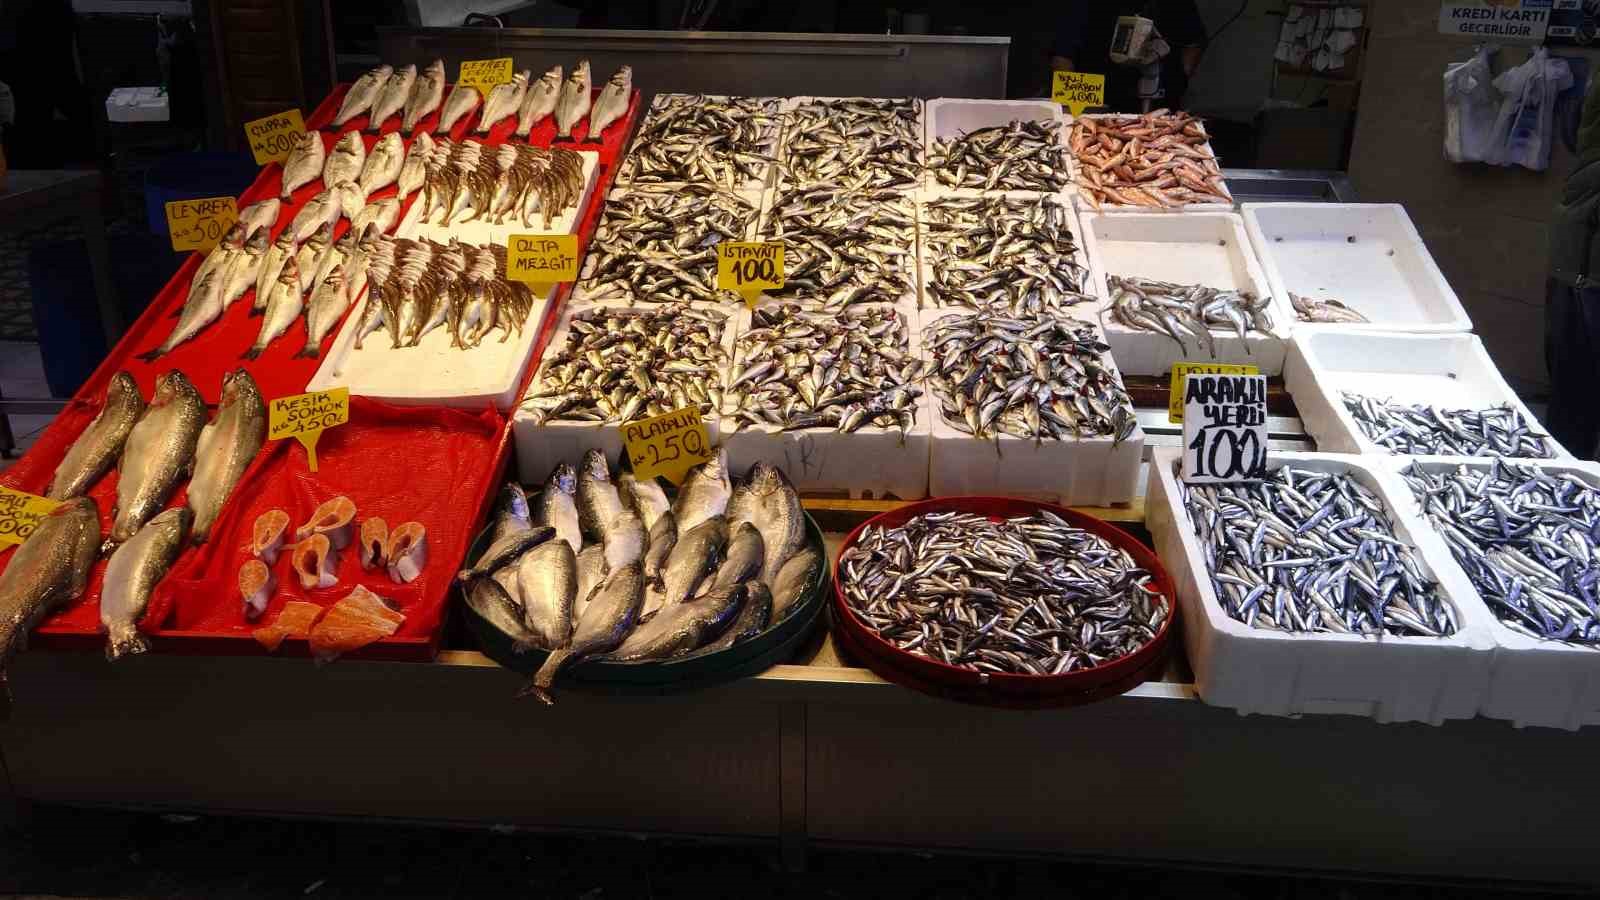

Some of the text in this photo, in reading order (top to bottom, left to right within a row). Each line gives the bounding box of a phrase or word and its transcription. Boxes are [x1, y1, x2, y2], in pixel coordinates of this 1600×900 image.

[1451, 7, 1545, 22] KREDİ KARTI
[172, 200, 233, 219] LEVREK
[516, 239, 560, 254] OLTA
[627, 411, 699, 442] ALABALIK
